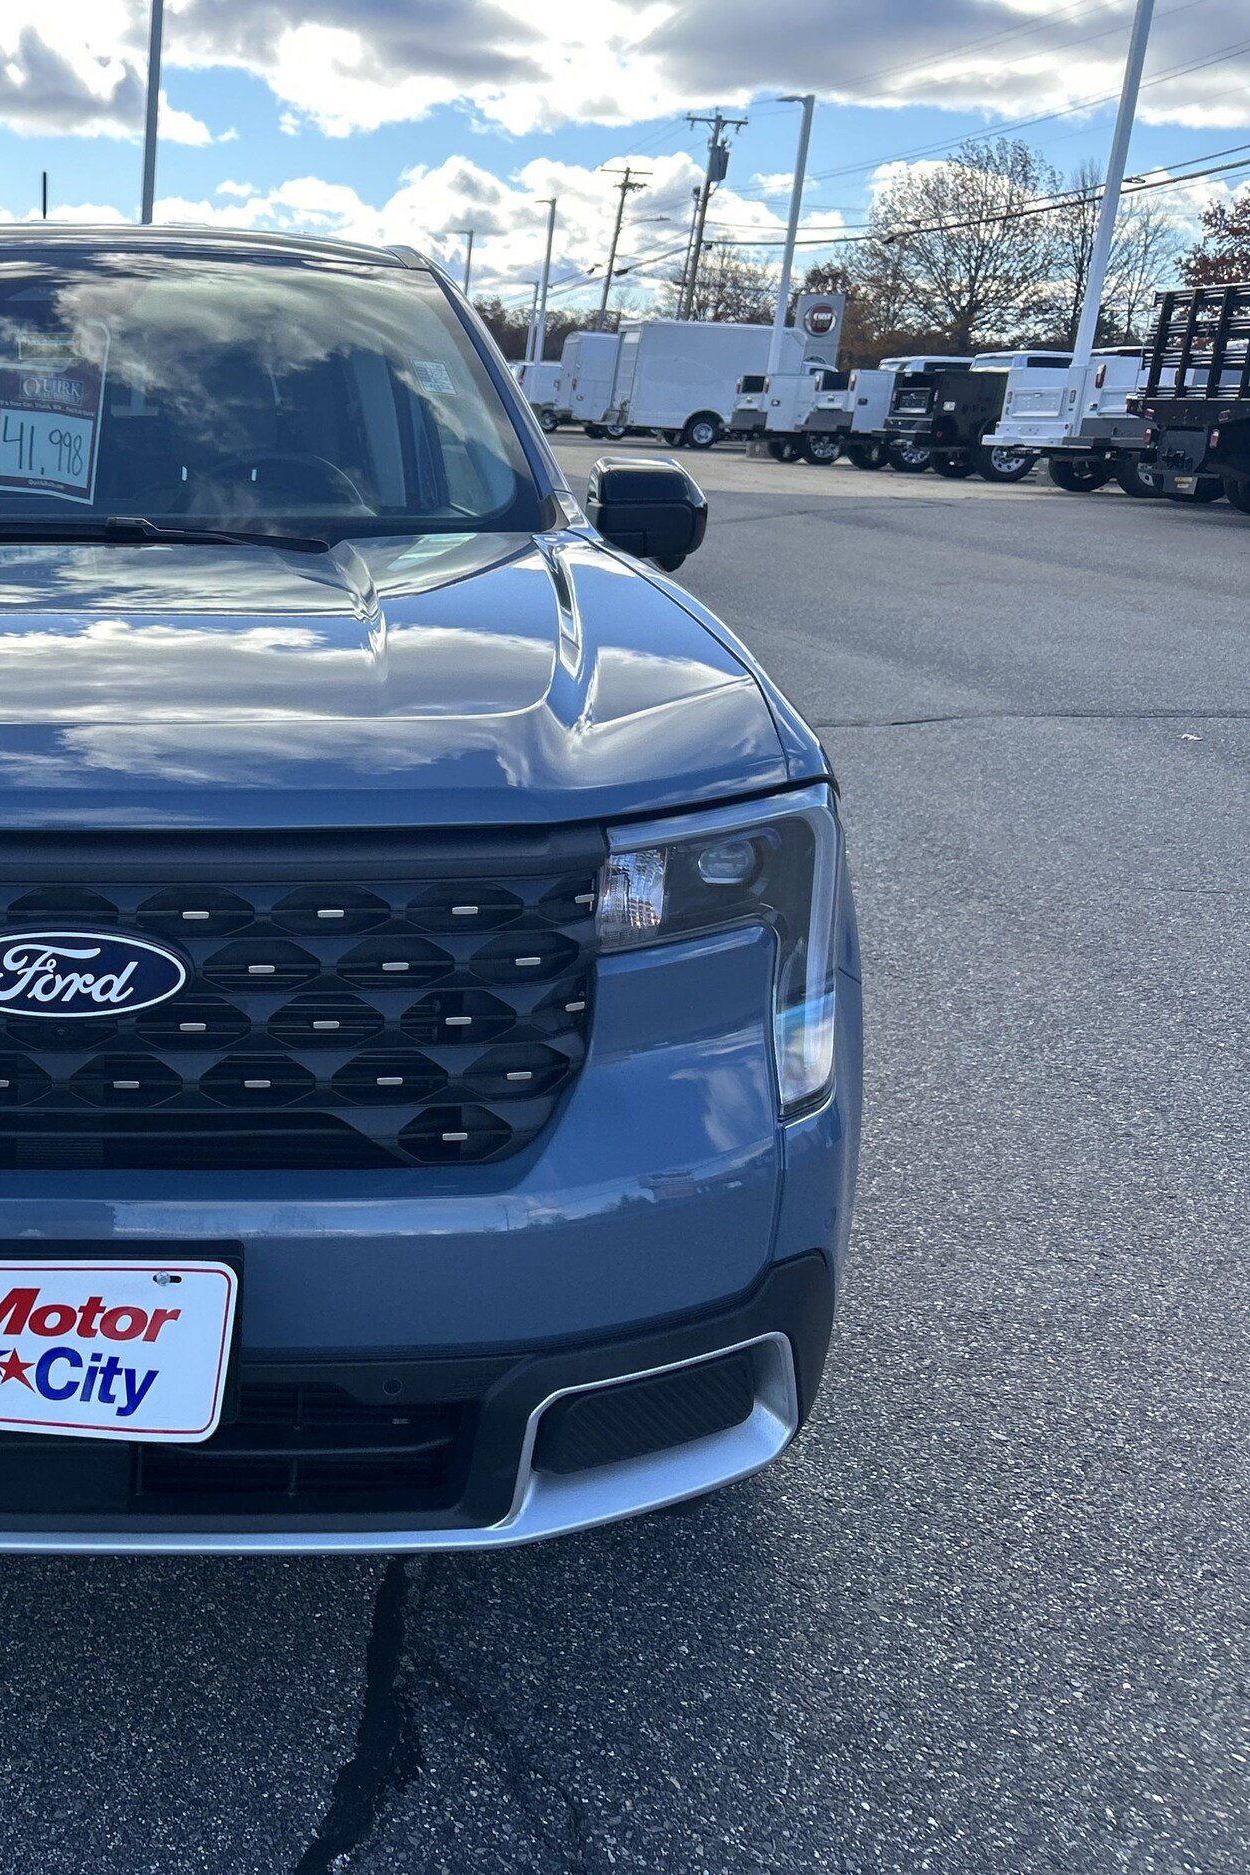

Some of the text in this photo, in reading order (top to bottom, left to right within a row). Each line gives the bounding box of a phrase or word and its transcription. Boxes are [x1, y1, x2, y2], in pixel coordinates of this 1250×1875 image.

[23, 377, 80, 397] QUIRK
[3, 415, 82, 476] 41,998
[35, 1346, 159, 1417] City
